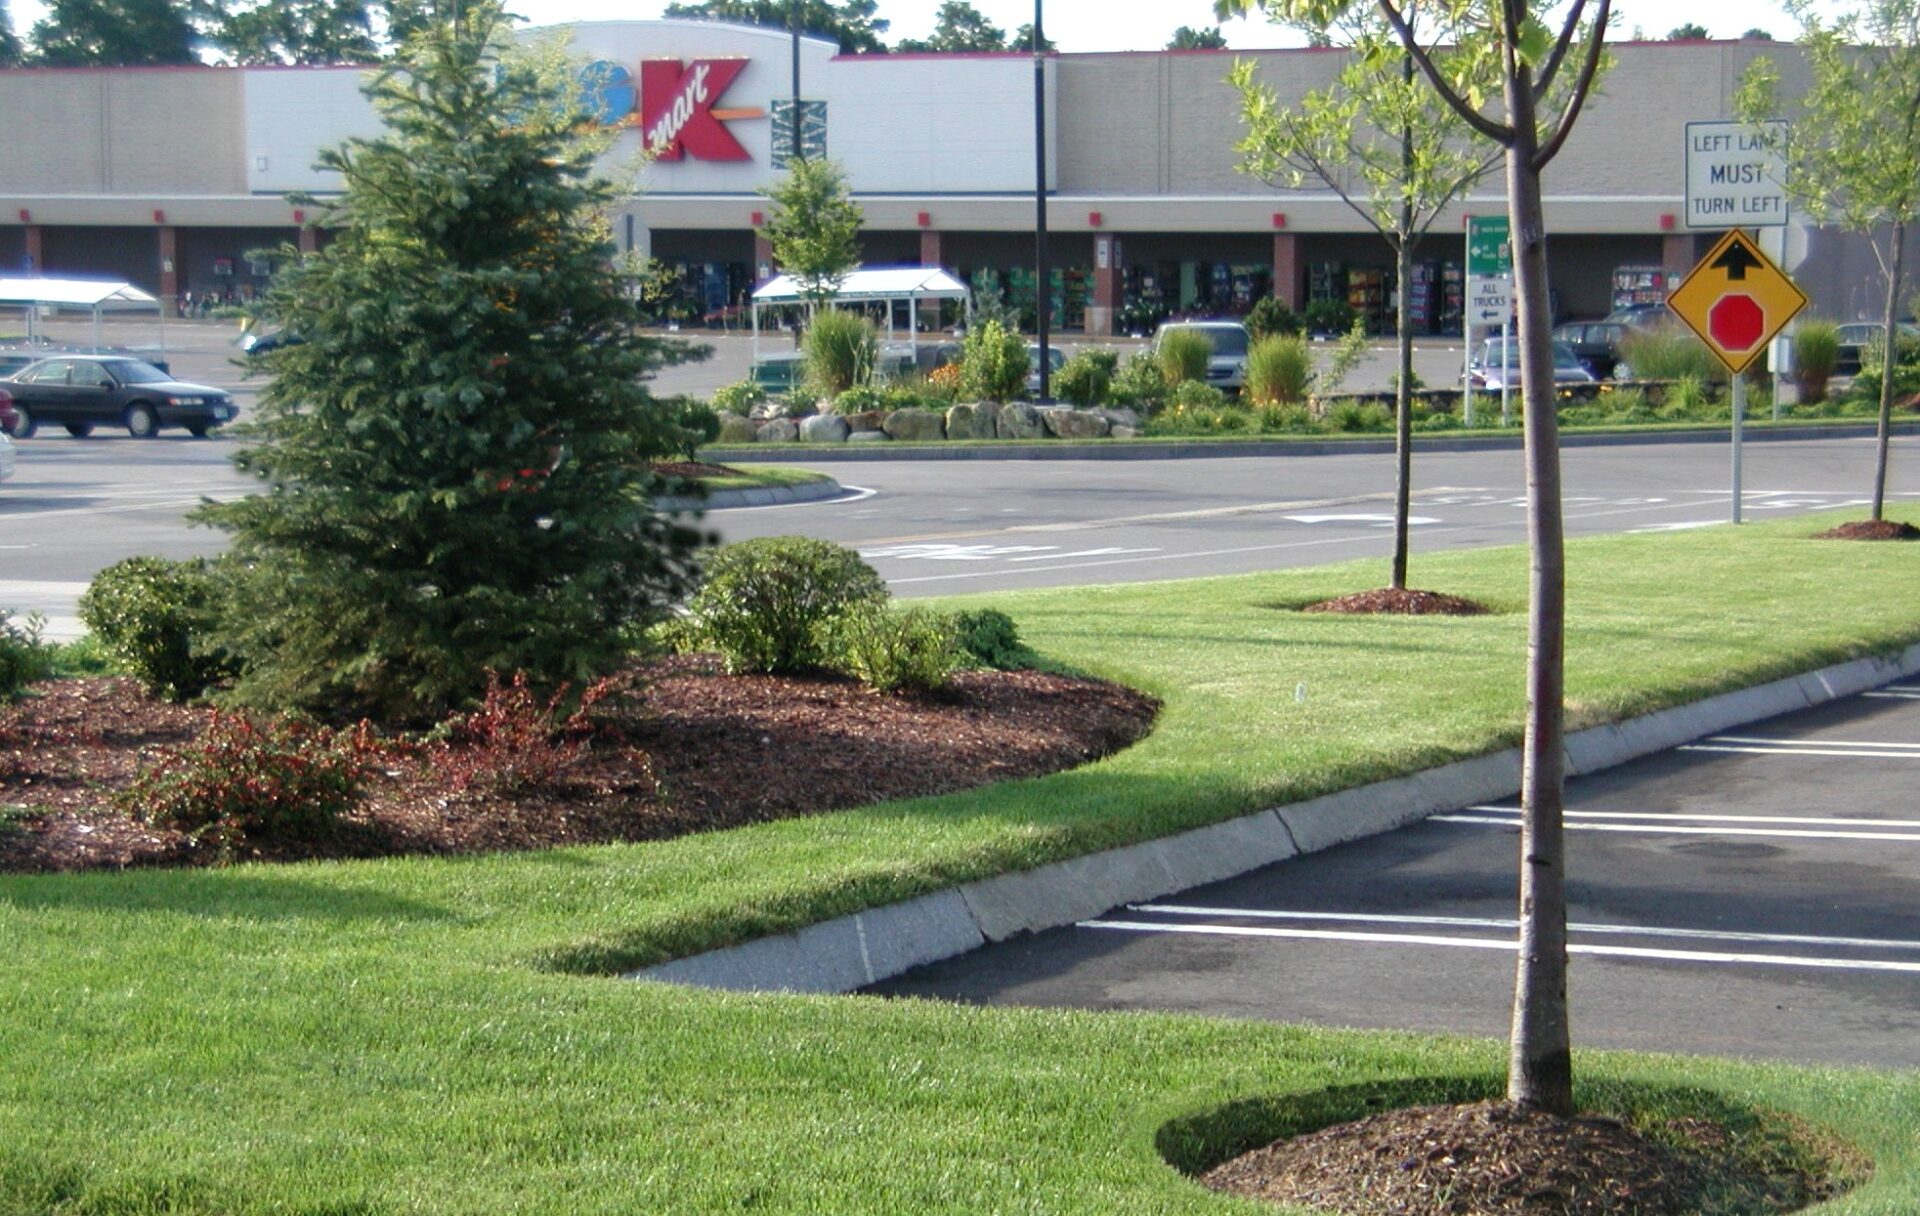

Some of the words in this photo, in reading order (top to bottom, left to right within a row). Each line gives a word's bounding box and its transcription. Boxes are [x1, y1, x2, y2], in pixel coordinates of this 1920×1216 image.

[1694, 135, 1731, 152] LEFT
[1710, 164, 1763, 184] MUST
[1694, 197, 1735, 214] TURN
[1743, 196, 1781, 213] LEFT
[1482, 284, 1497, 294] ALL
[1473, 296, 1506, 307] TRUCKS
